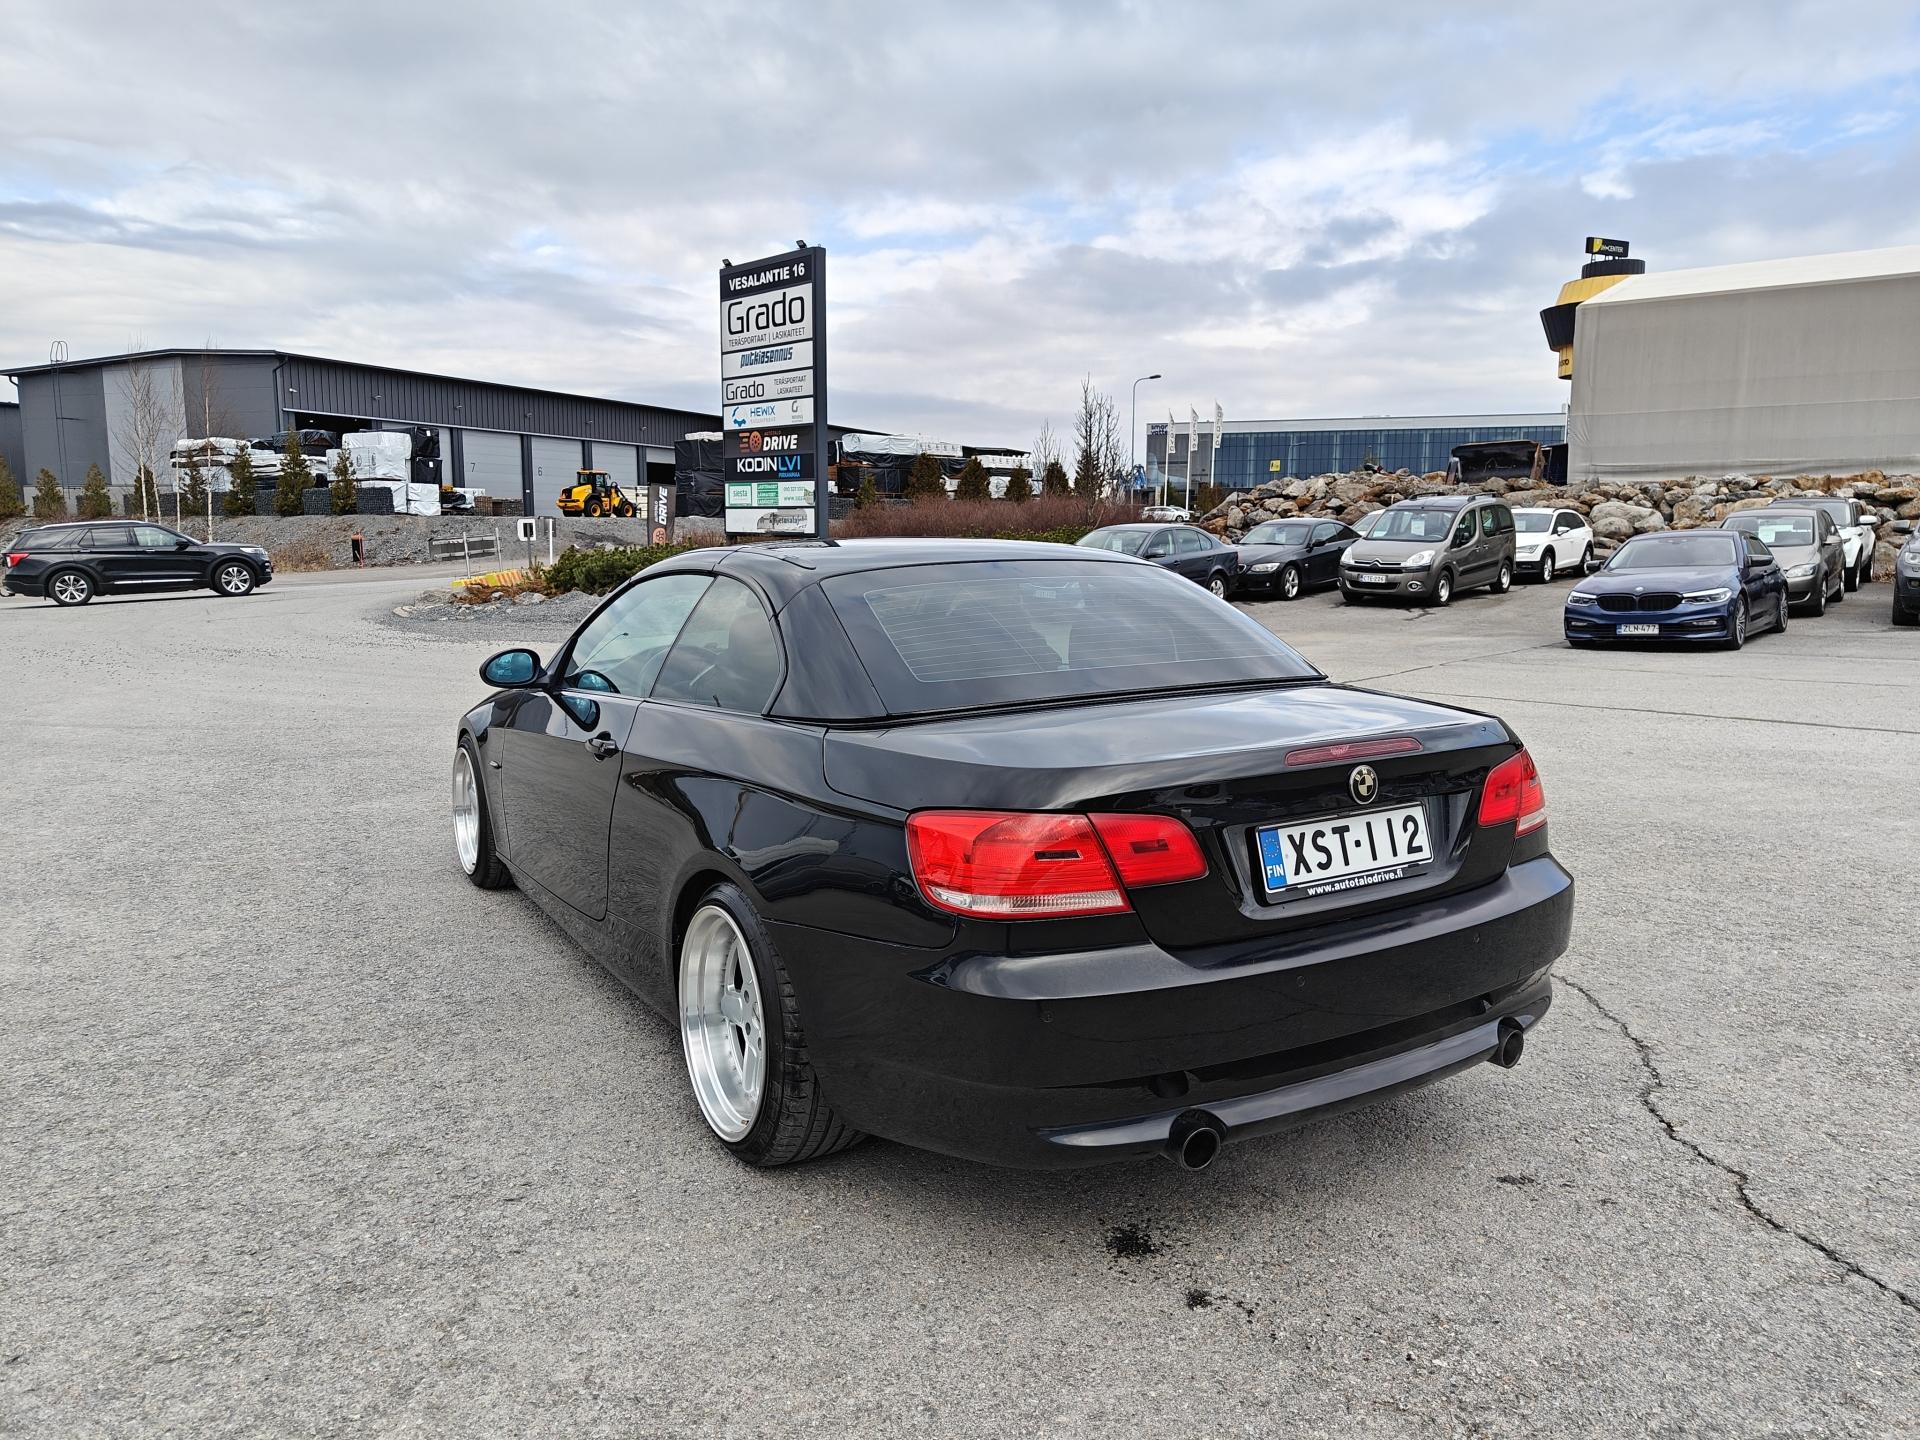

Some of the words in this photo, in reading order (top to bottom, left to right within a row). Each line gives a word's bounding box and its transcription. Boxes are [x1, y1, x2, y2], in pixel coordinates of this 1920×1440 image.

[729, 266, 790, 291] VESALANTIE
[792, 262, 805, 277] 16
[727, 291, 805, 335] Grado
[772, 326, 806, 340] LASIKAITEET
[740, 346, 793, 369] putkiasennus
[726, 380, 765, 401] Grado
[776, 385, 803, 395] LASIKAITEET
[750, 405, 776, 417] HEWIX
[763, 435, 798, 451] DRIVE
[470, 462, 476, 473] 7
[537, 467, 543, 477] 6
[658, 486, 668, 526] DRIVE
[1266, 863, 1284, 879] FIN
[1307, 868, 1404, 896] www.autotalodrive.fi
